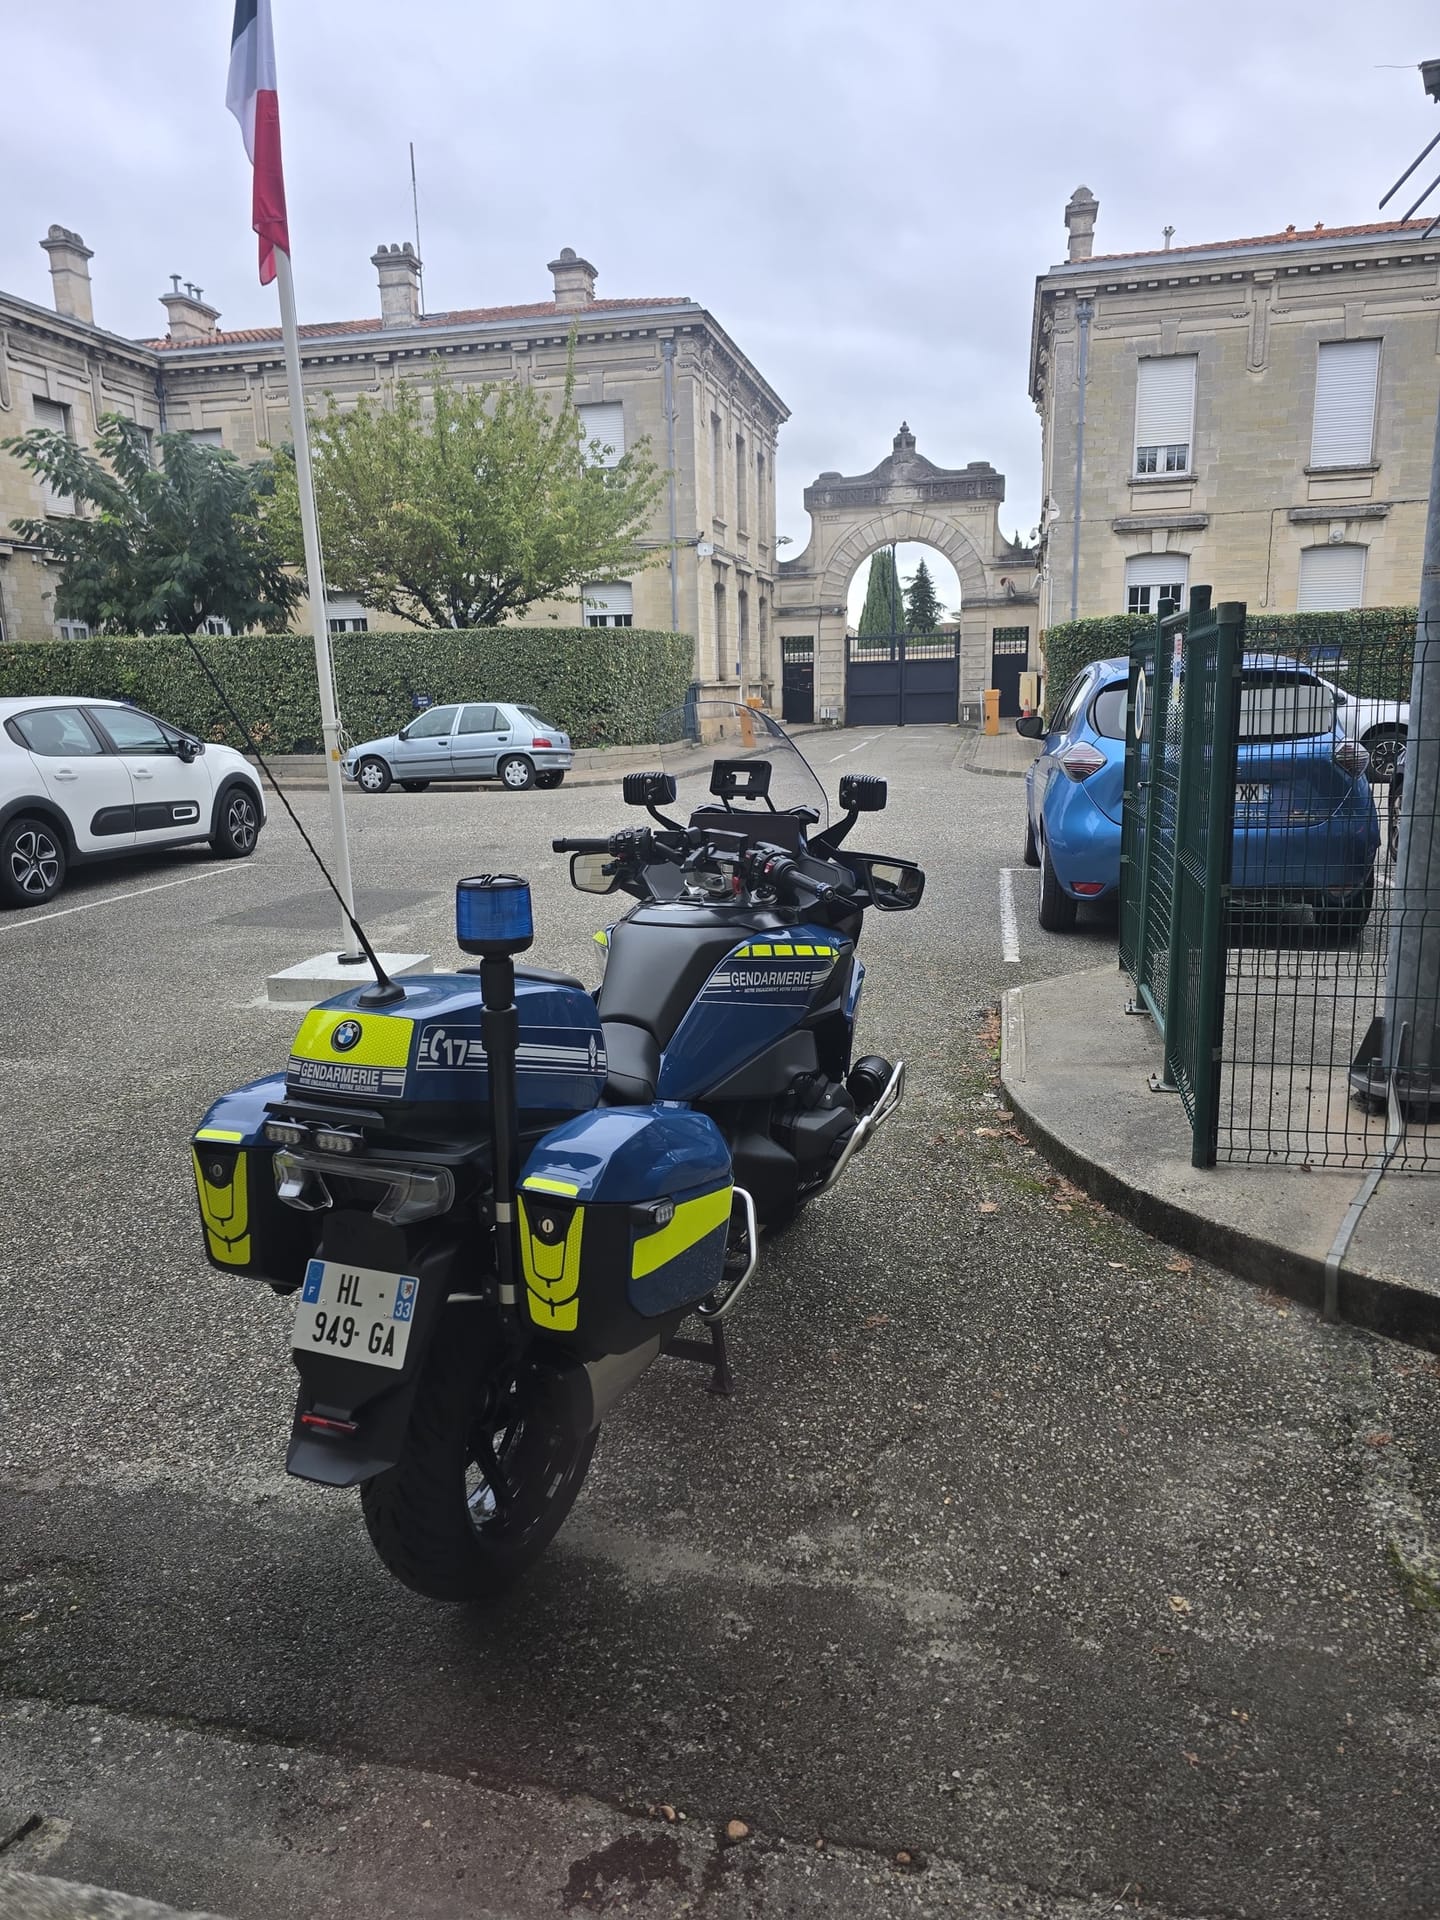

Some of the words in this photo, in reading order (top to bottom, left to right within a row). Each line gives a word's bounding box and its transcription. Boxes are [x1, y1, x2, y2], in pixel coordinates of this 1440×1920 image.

[731, 971, 811, 986] GENDARMERIE
[442, 1039, 467, 1066] 17
[301, 1062, 380, 1085] GENDARMERIE
[308, 1286, 316, 1296] F
[337, 1273, 363, 1307] HL
[394, 1300, 411, 1318] 33
